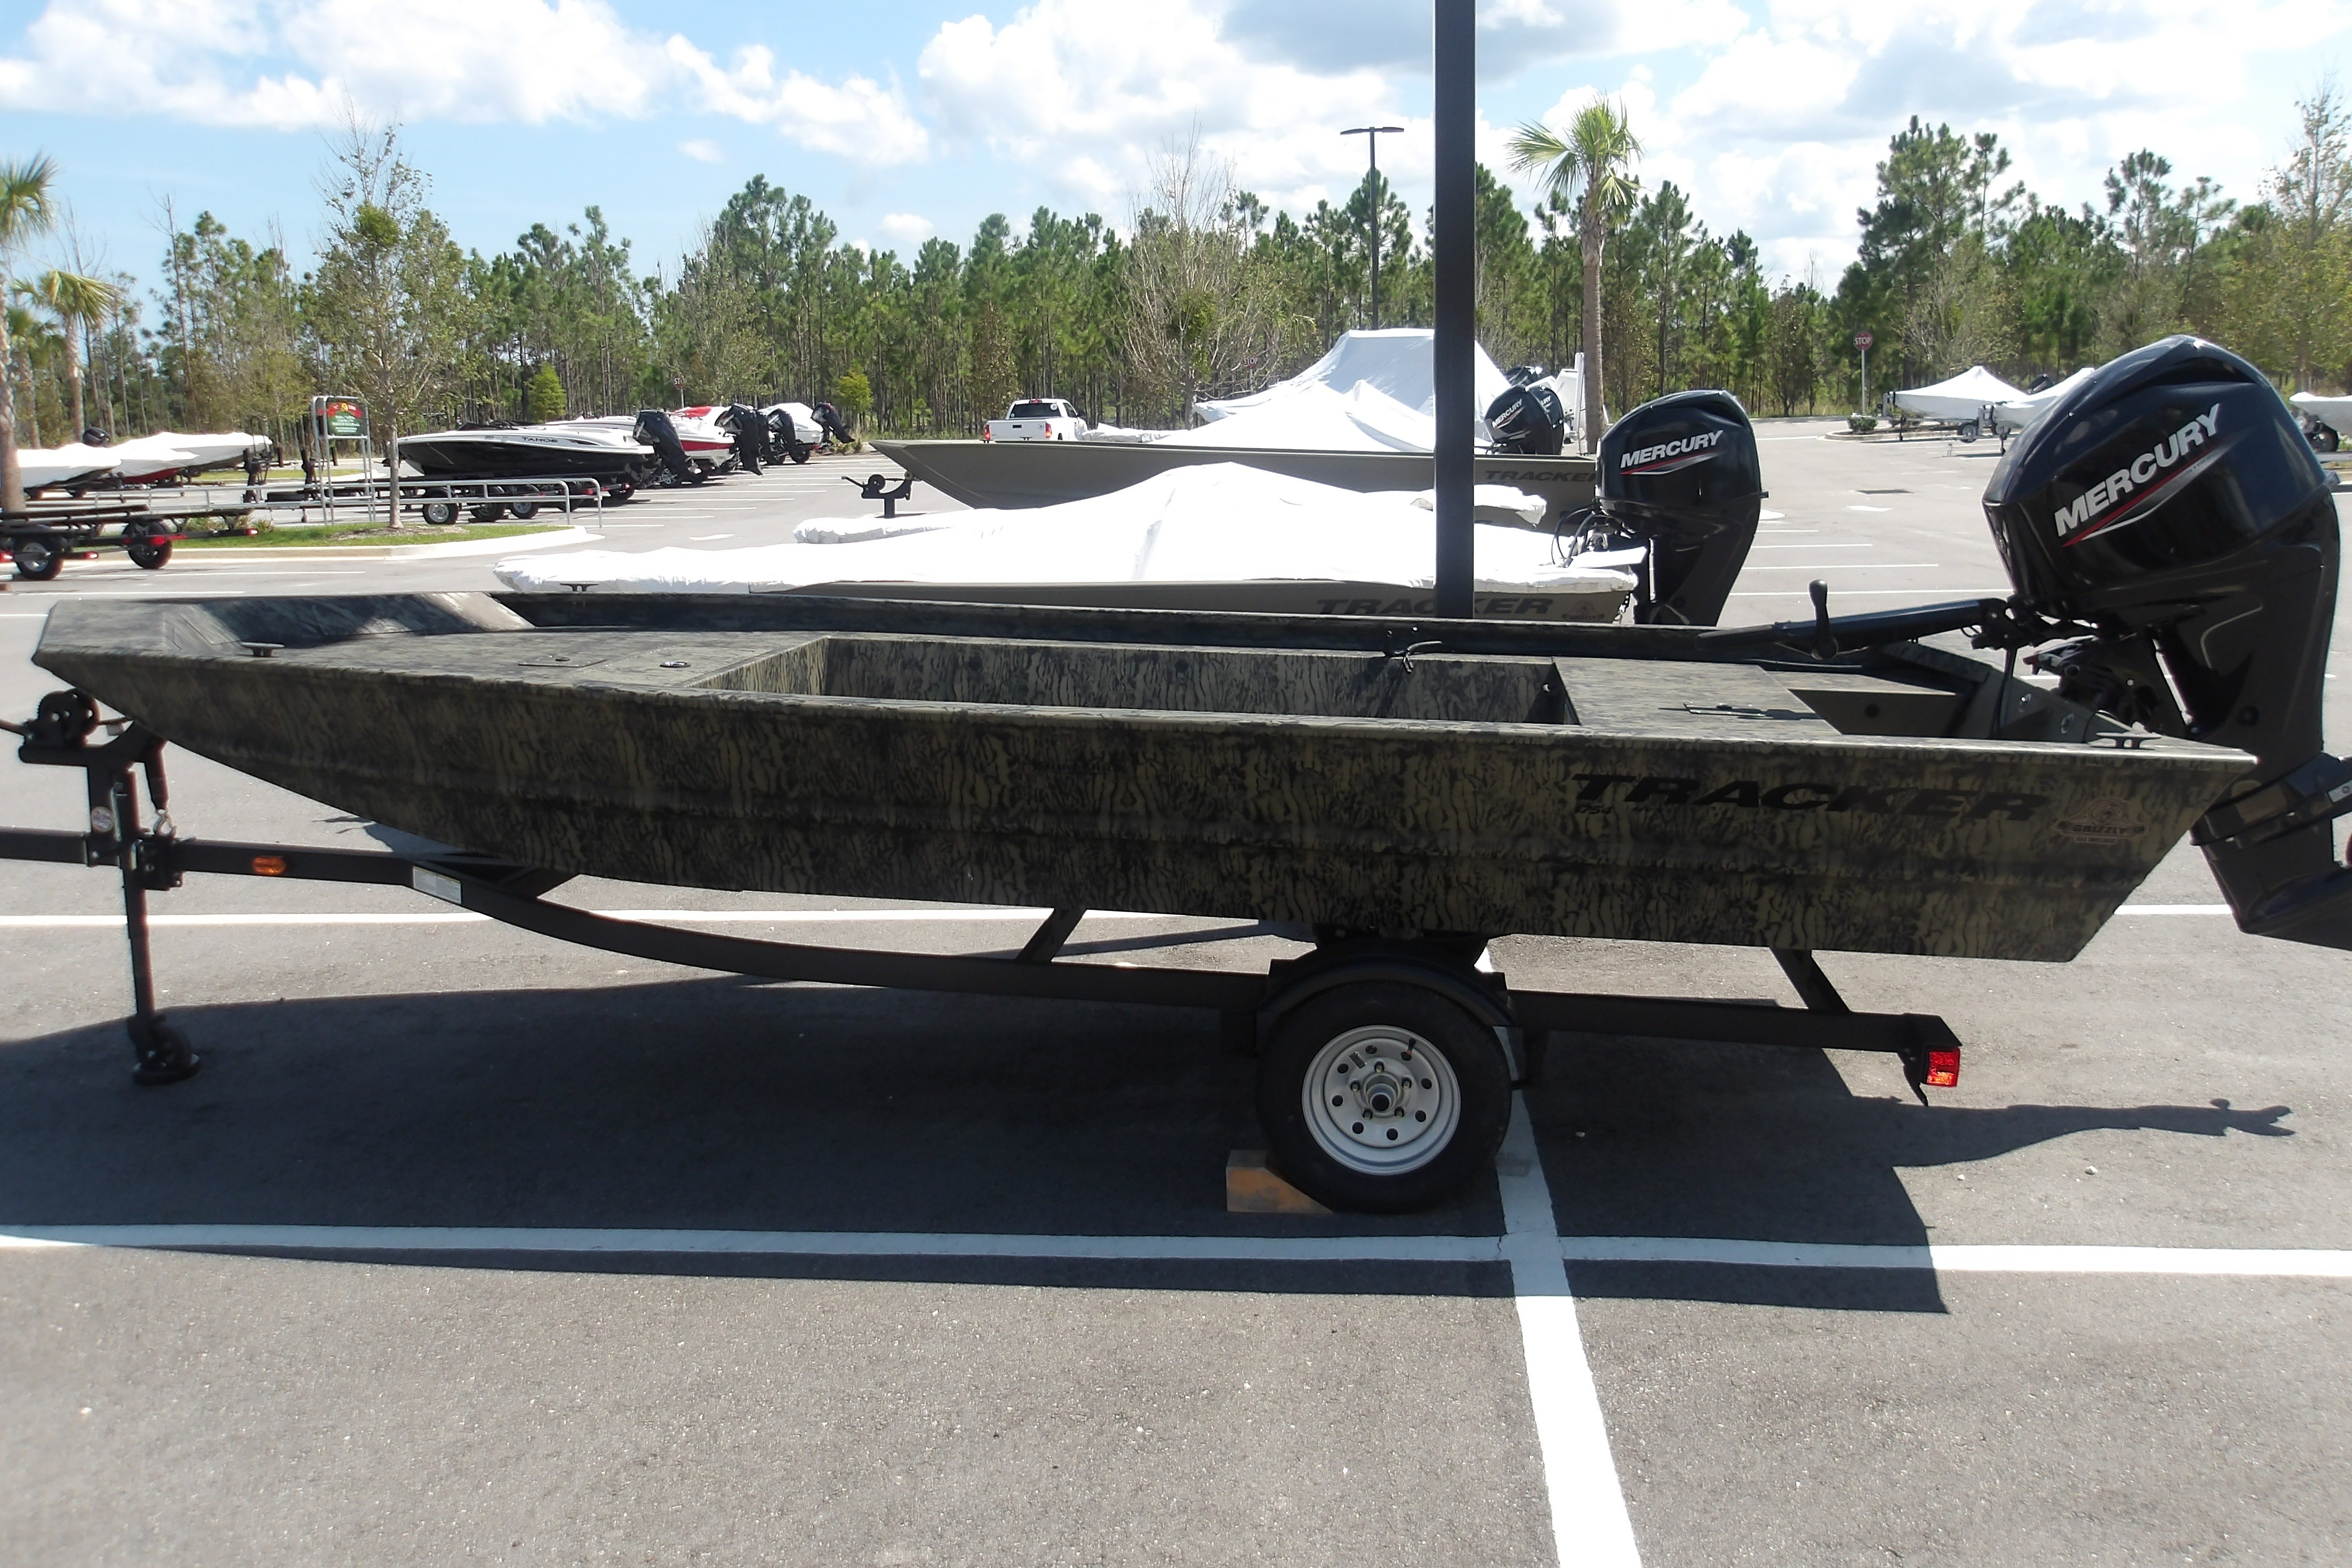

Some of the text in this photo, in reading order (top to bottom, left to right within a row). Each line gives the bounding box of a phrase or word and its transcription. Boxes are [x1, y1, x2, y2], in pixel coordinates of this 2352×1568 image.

[1491, 398, 1523, 428] MERCURY
[1620, 430, 1724, 468] MERCURY
[2053, 402, 2221, 537] MERCURY
[1317, 598, 1554, 614] TRACER
[1571, 773, 2048, 821] TRACKER
[2072, 824, 2127, 835] GRIZZLY
